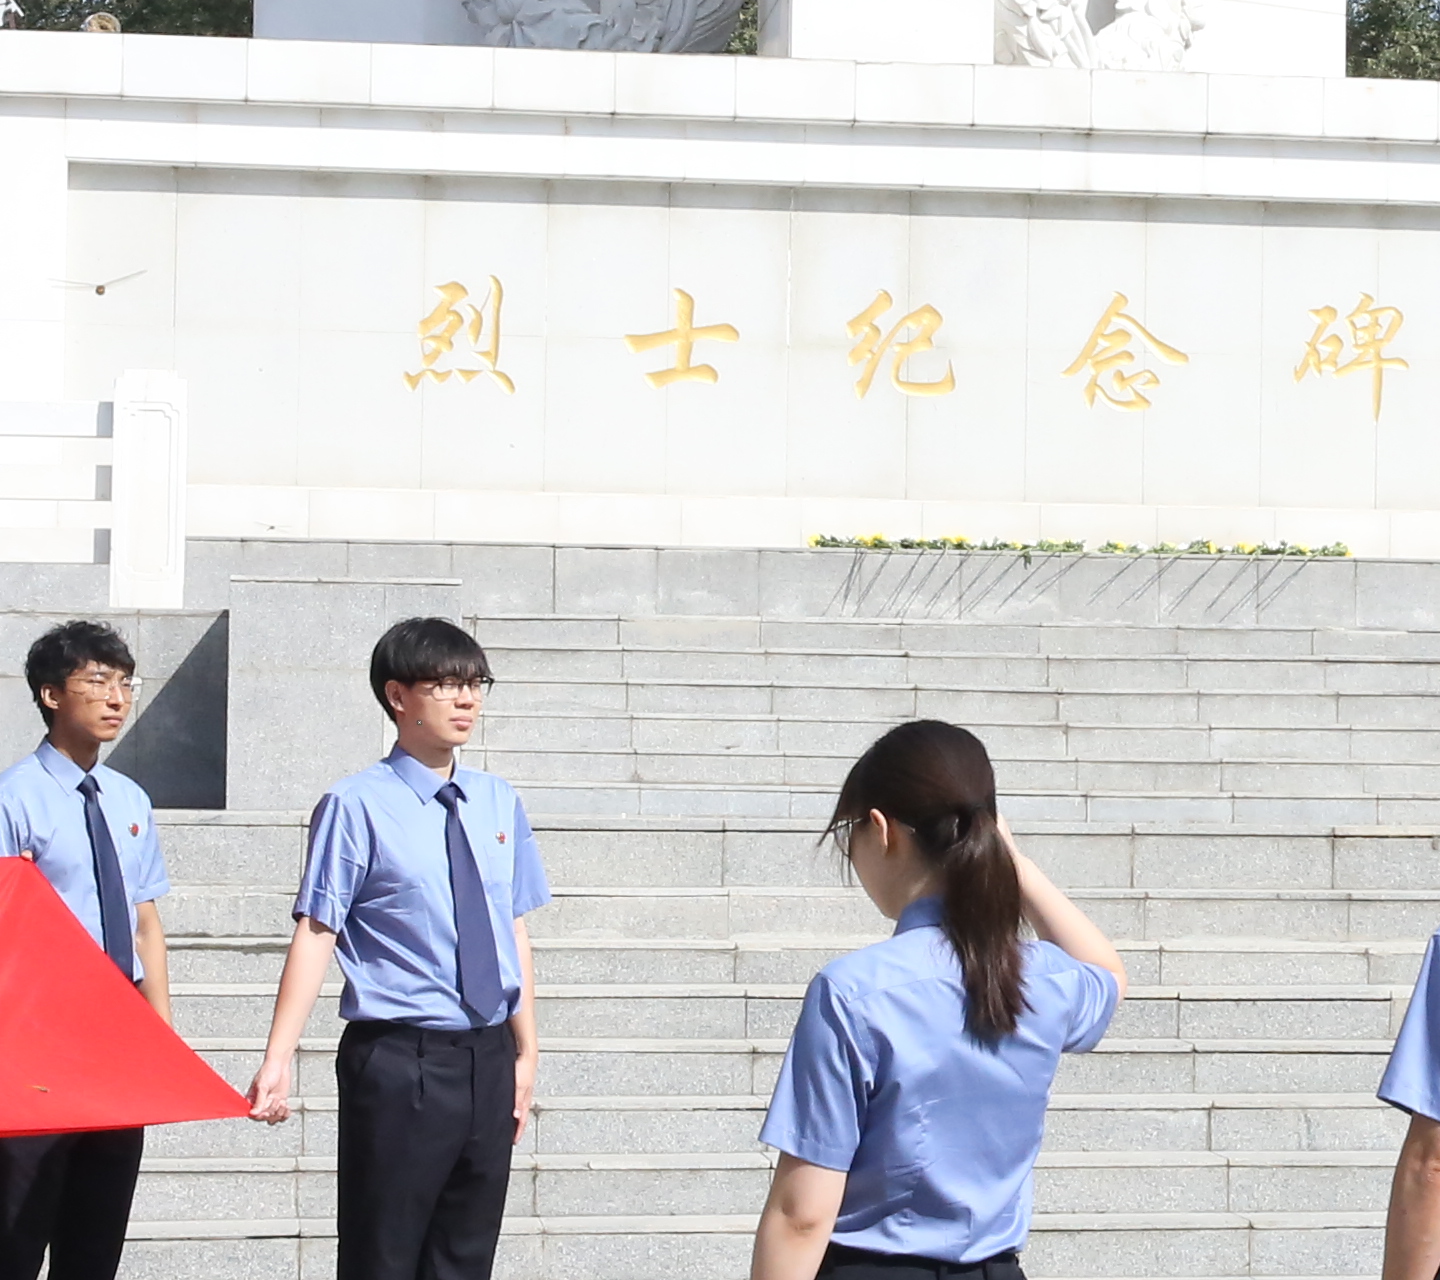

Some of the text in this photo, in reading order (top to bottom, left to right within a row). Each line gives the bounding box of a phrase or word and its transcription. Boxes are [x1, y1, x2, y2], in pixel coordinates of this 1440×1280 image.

[403, 274, 1410, 423] 烈士纪念碑
